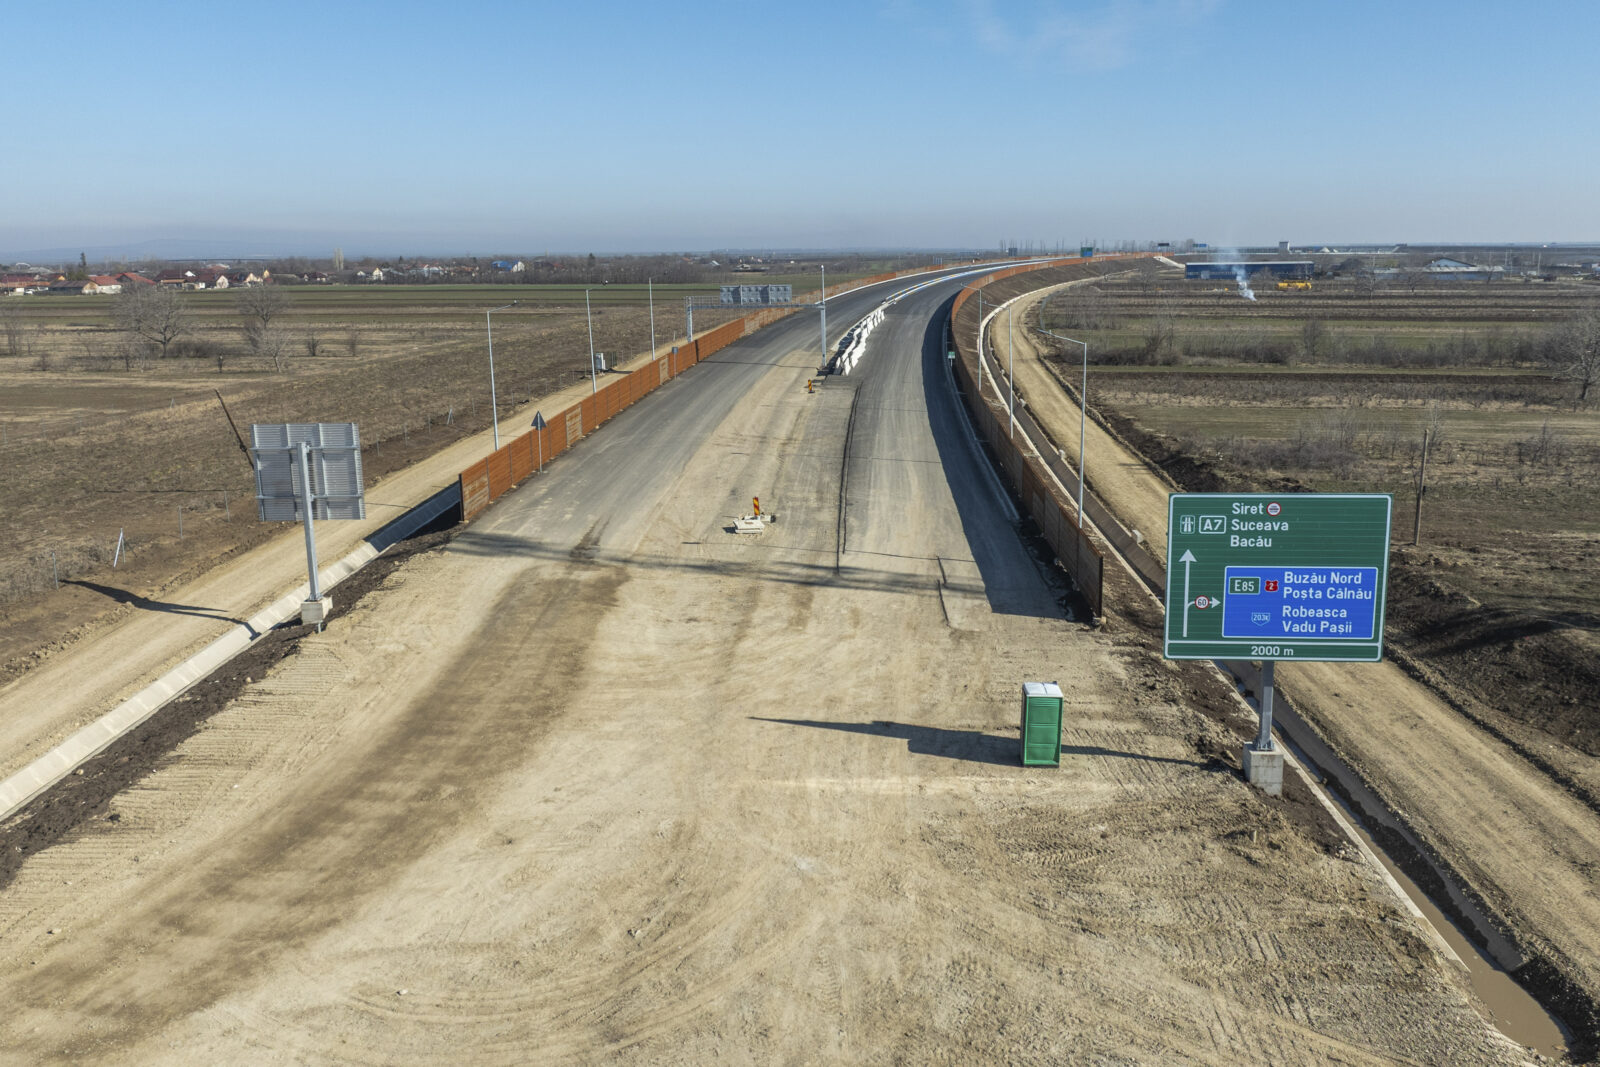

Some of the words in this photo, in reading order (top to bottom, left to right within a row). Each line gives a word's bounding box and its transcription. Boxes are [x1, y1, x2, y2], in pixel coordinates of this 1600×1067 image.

[1232, 503, 1264, 514] Siret
[1203, 520, 1222, 530] A7
[1231, 519, 1289, 531] Suceava
[1230, 535, 1272, 547] Bacău
[1284, 571, 1326, 584] Buzău
[1330, 572, 1362, 584] Nord
[1234, 580, 1254, 592] E85
[1269, 582, 1274, 590] 2
[1283, 587, 1322, 600] Poșta
[1282, 605, 1347, 618] Robeasca
[1282, 621, 1316, 632] Vadu
[1320, 621, 1352, 634] Pașii
[1251, 646, 1280, 656] 2000
